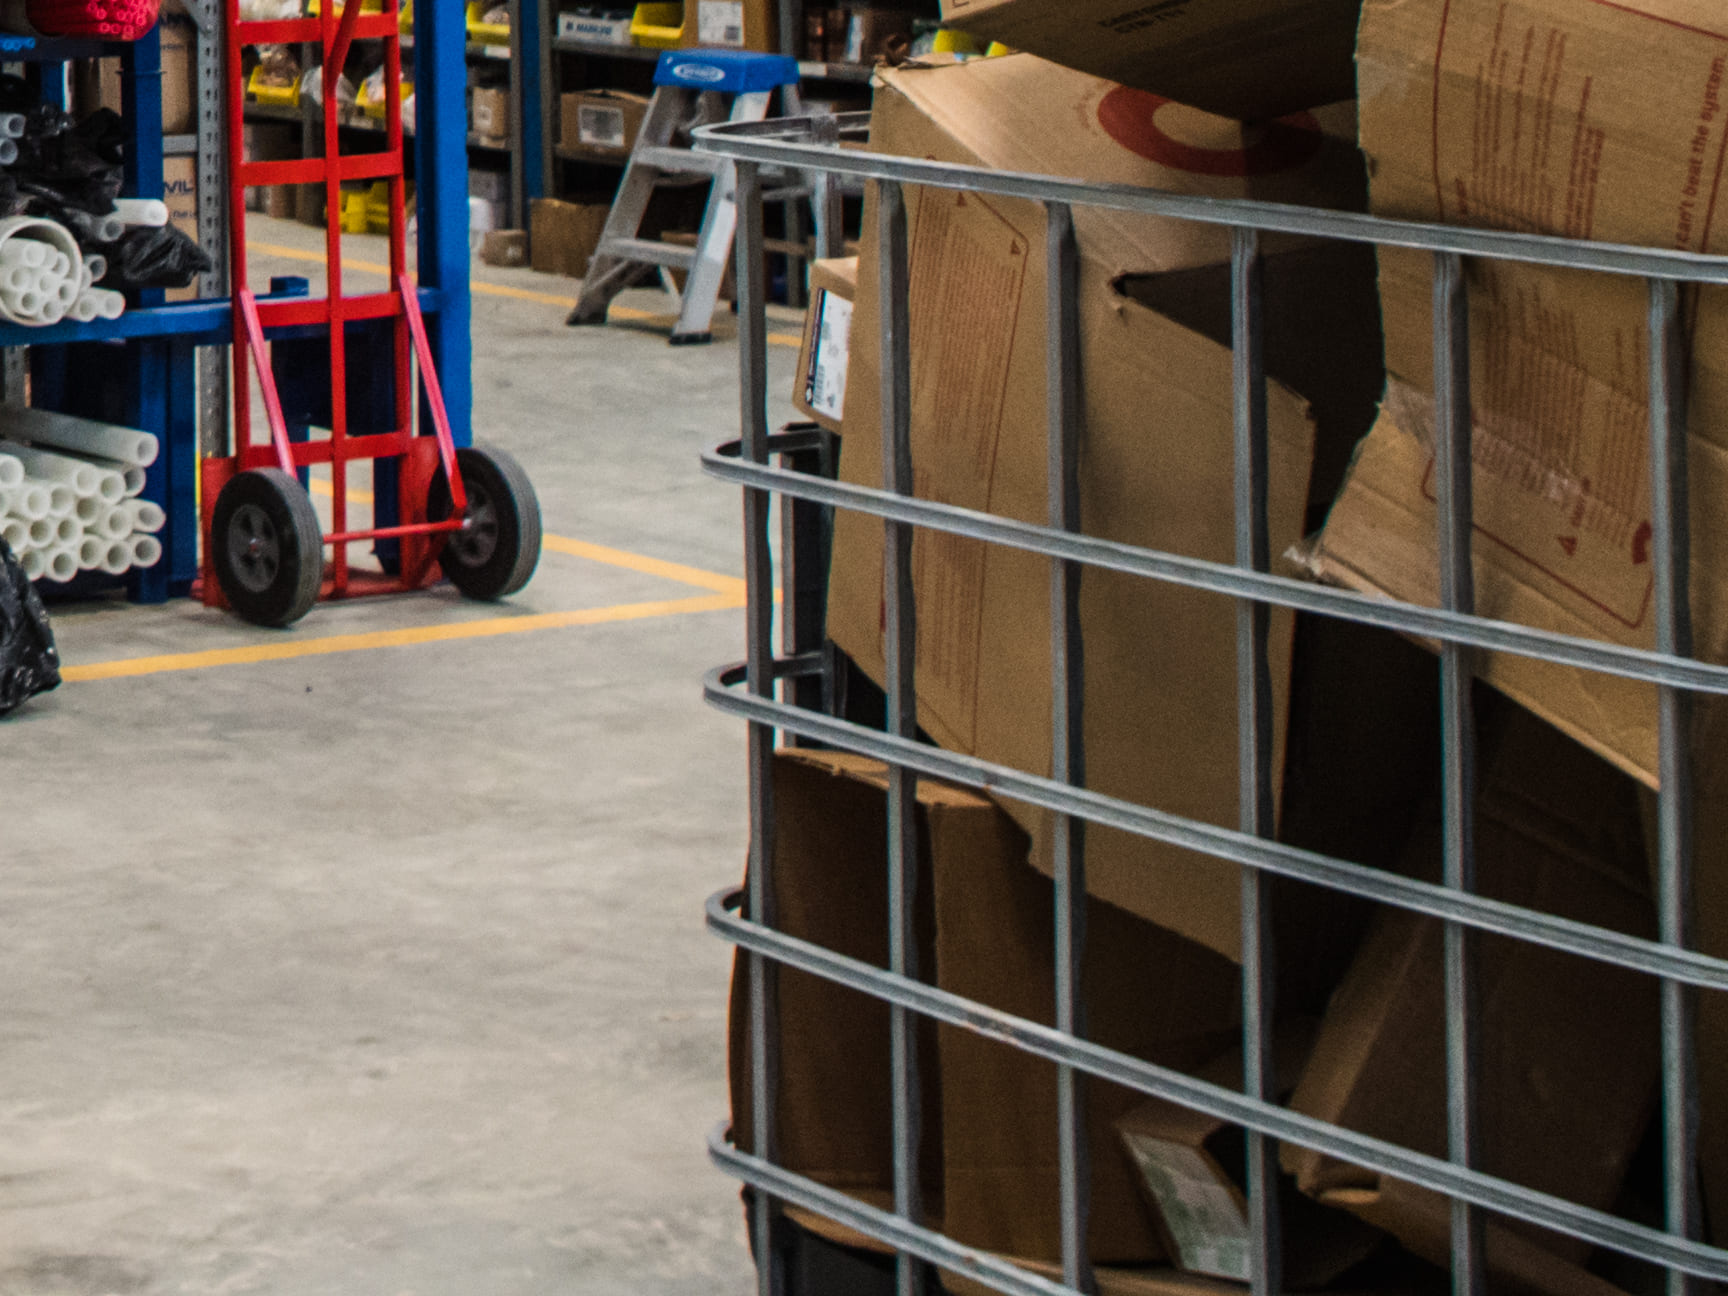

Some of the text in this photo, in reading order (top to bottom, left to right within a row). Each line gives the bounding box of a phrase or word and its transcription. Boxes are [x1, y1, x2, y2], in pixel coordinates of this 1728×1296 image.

[1699, 56, 1726, 123] system
[1691, 124, 1710, 154] the
[1682, 158, 1704, 197] beat
